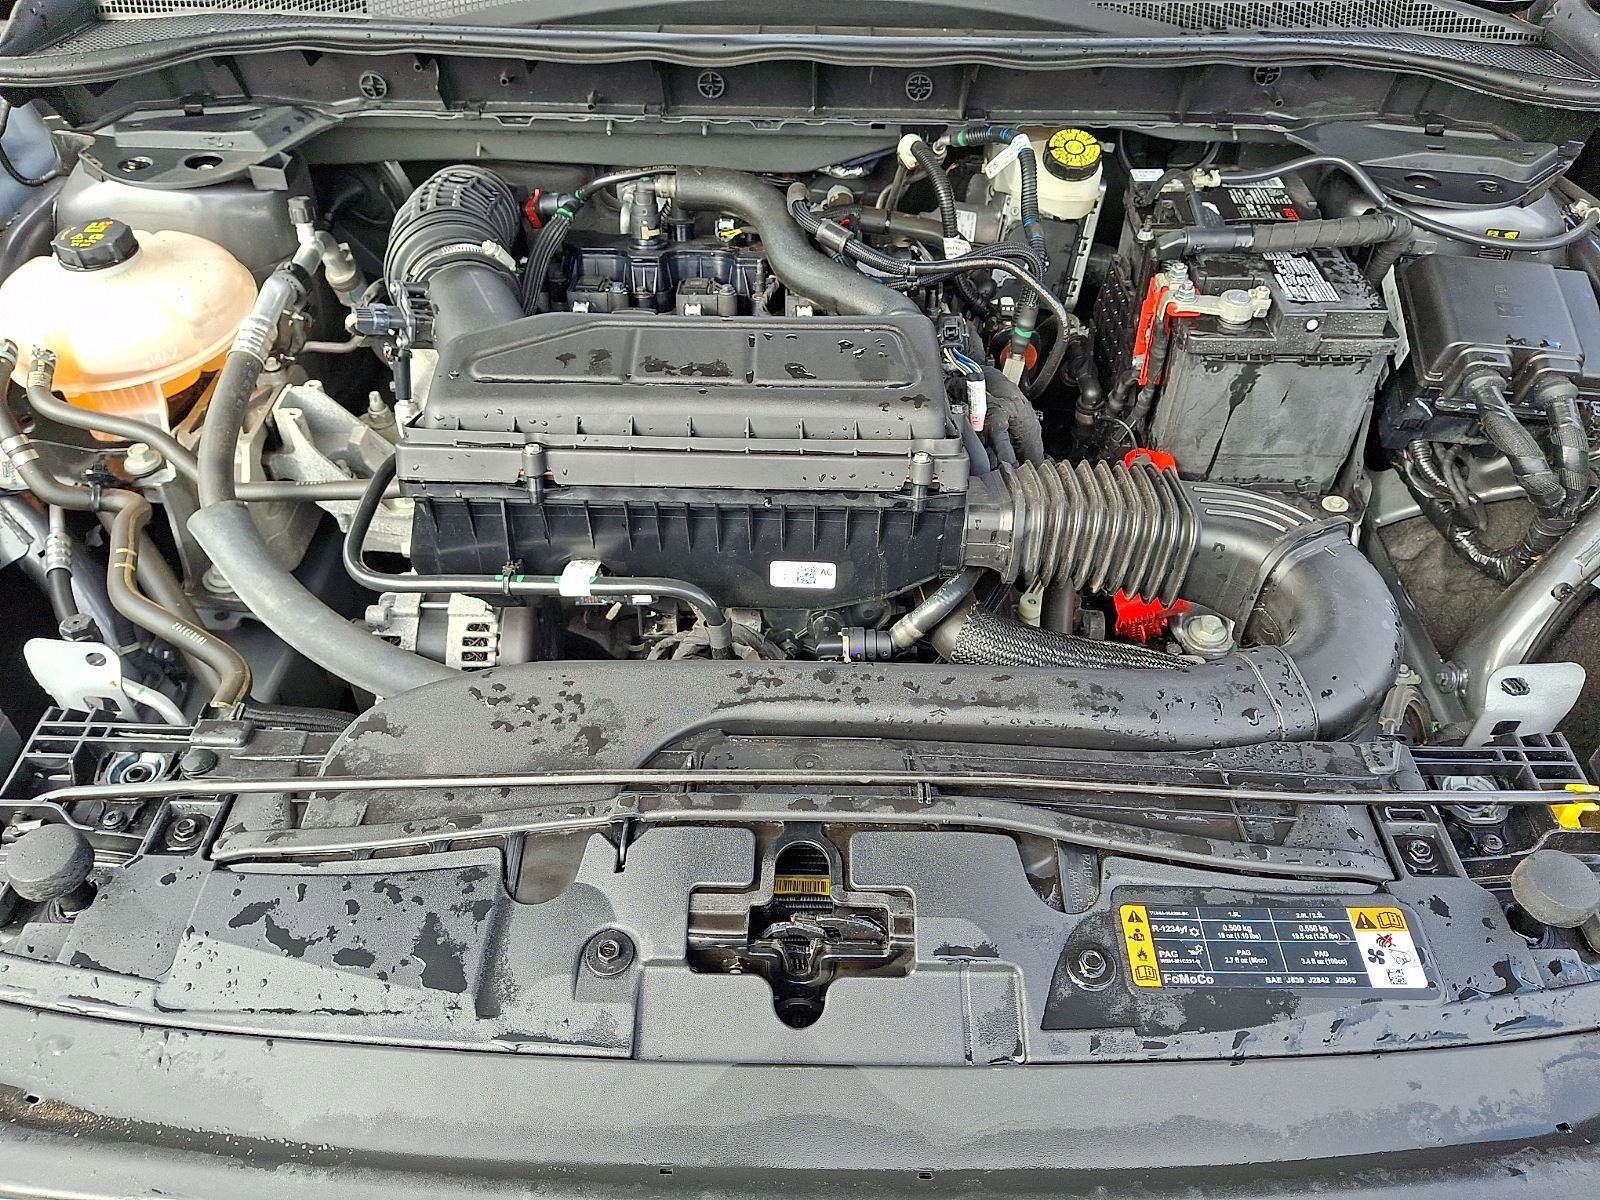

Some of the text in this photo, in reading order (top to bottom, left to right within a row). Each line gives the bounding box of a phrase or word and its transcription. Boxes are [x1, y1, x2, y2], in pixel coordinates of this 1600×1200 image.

[1151, 924, 1188, 935] R-1234yf
[1222, 924, 1253, 933] 0.500 kg
[1298, 924, 1329, 934] 0.550 kg
[1158, 950, 1179, 958] PAG
[1163, 973, 1215, 985] FoMoCo
[1265, 976, 1283, 984] SAE
